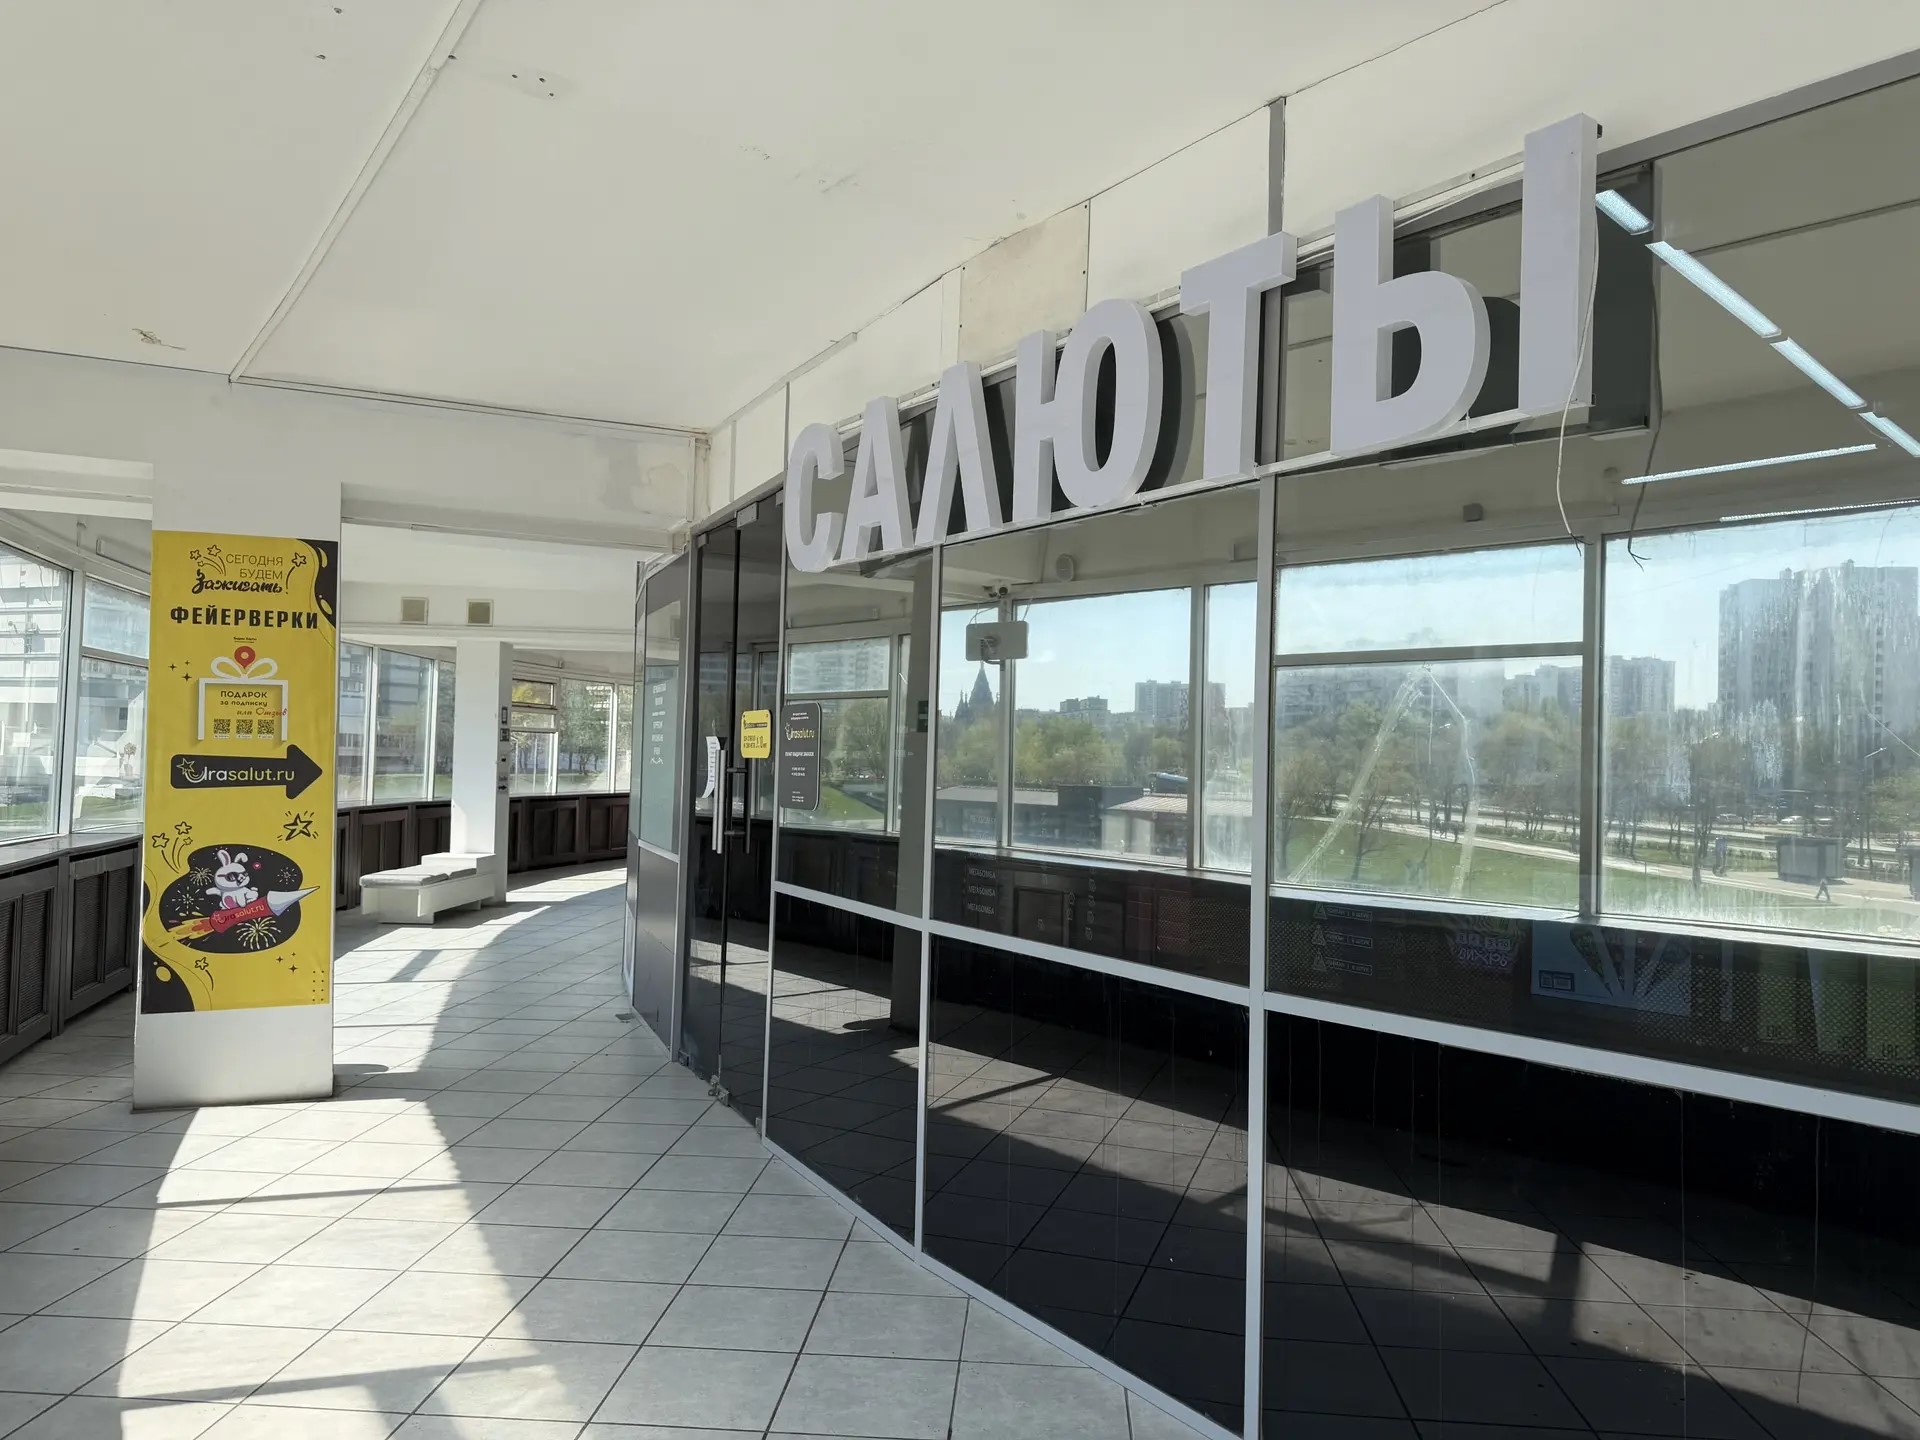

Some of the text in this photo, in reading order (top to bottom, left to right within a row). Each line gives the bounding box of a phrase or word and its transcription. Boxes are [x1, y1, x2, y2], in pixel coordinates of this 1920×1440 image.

[783, 111, 1599, 573] САЛЮТЫ
[225, 553, 284, 567] СЕГОДНЯ
[239, 568, 283, 580] БУДЕМ
[170, 604, 318, 629] ФЕЙЕРВЕРКИ
[220, 690, 268, 699] ПОДАРОК
